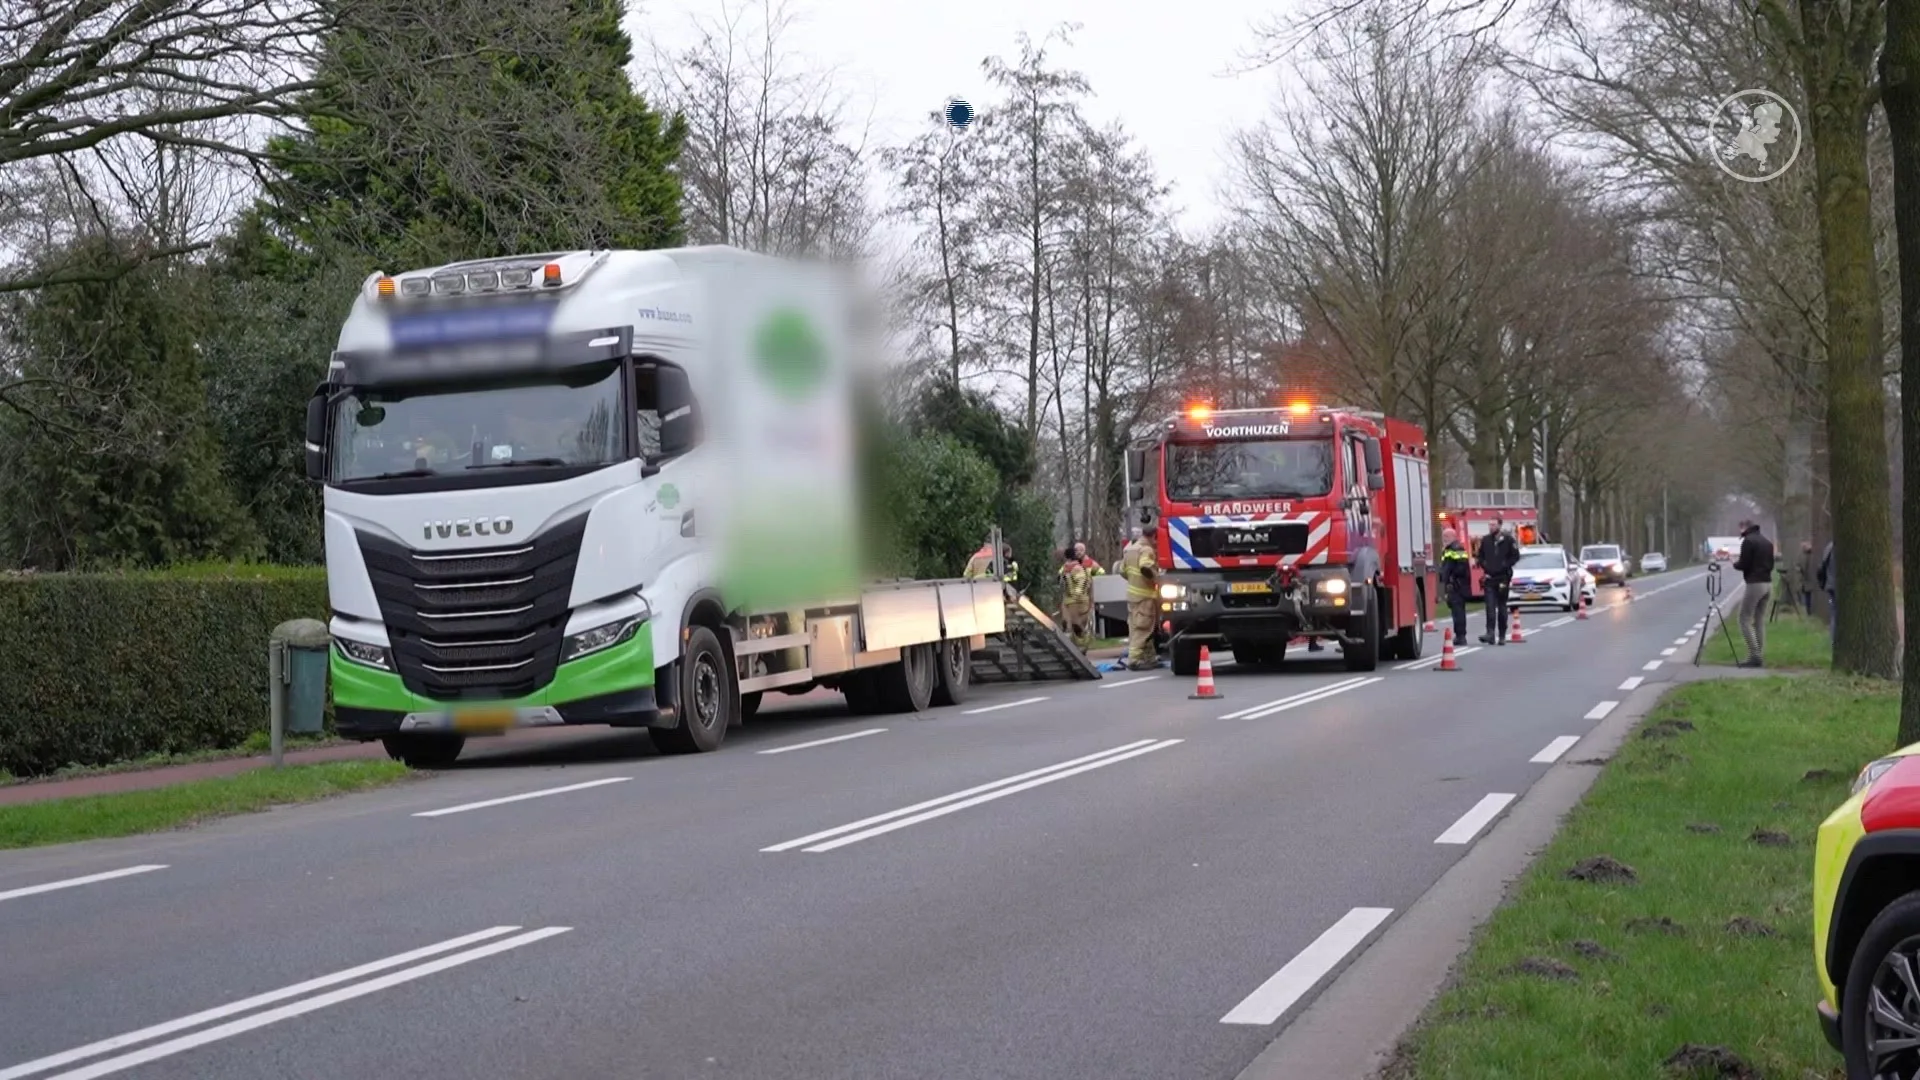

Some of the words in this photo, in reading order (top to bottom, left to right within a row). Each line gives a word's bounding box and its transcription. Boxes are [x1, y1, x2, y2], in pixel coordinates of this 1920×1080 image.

[1206, 425, 1289, 437] VOORTHUIZEN
[1204, 502, 1291, 515] BRANDWEER
[423, 515, 514, 540] IVECO
[1228, 532, 1269, 544] MAN
